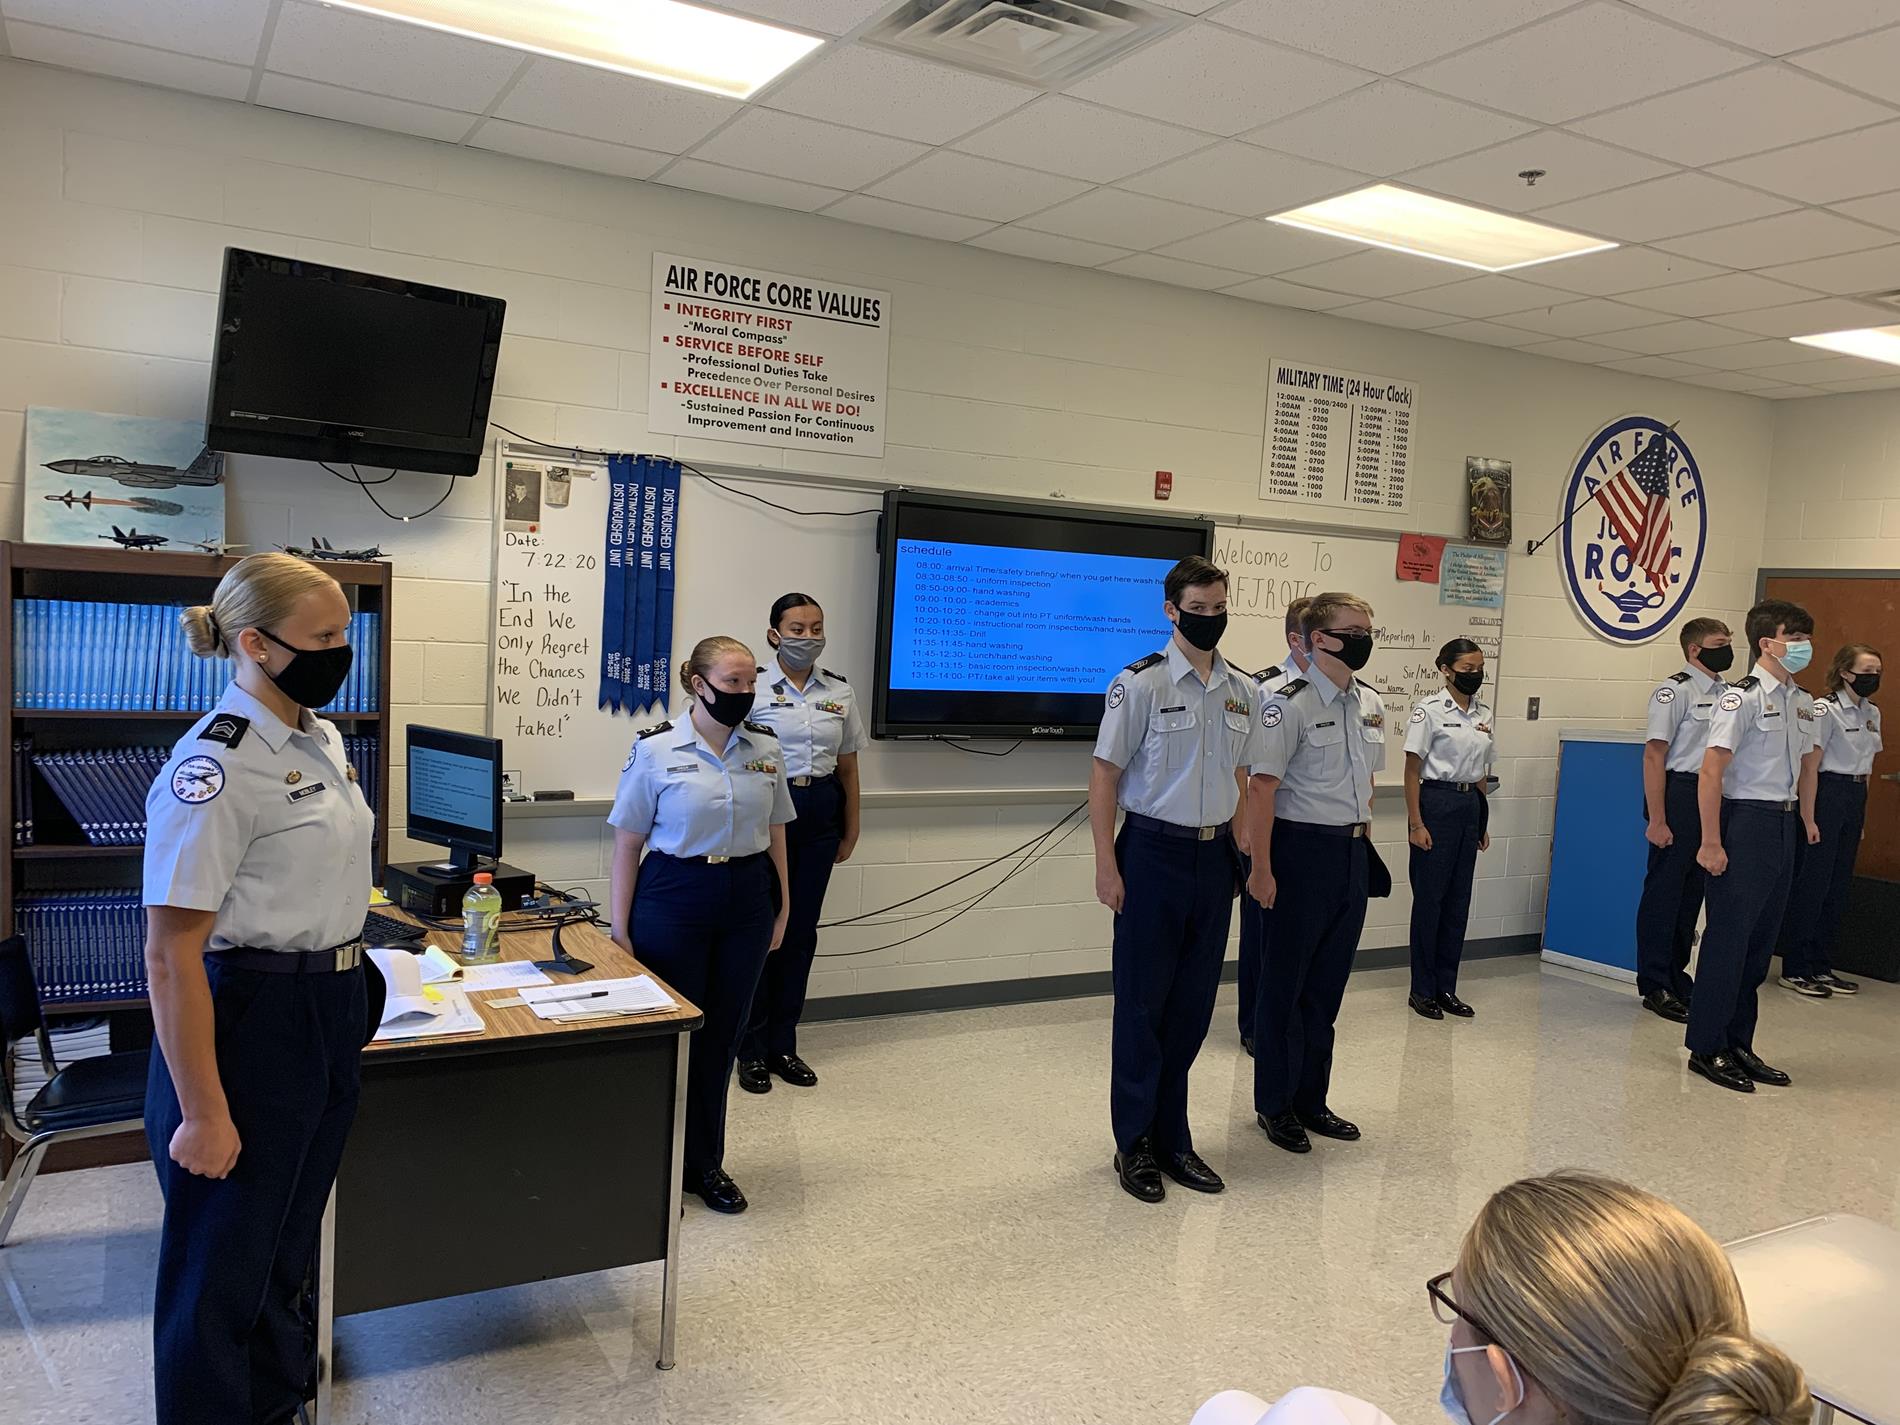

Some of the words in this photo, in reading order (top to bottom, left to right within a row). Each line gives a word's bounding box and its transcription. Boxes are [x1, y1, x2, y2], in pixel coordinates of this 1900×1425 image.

[666, 265, 697, 291] AIR
[704, 271, 760, 301] FORCE
[767, 282, 812, 310] CORE
[818, 290, 880, 321] VALUES
[677, 303, 752, 324] INTEGRITY
[756, 316, 792, 331] FIRST
[732, 328, 787, 345] Compass"
[676, 336, 732, 354] SERVICE
[738, 345, 789, 362] BEFORE
[794, 353, 823, 367] SELF
[764, 364, 798, 378] Duties
[802, 370, 828, 382] Take
[688, 368, 751, 385] Precedence
[753, 377, 781, 390] Over
[785, 381, 833, 396] Personal
[836, 389, 875, 402] Desires
[1277, 367, 1320, 389] MILITARY
[1323, 375, 1344, 393] TIME
[1346, 379, 1360, 399] (24
[1363, 382, 1384, 400] Hour
[1387, 385, 1412, 408] Clock)
[674, 382, 759, 403] EXCELLENCE
[764, 394, 780, 405] IN
[784, 396, 808, 409] ALL
[812, 400, 831, 412] WE
[836, 403, 860, 416] DO!
[1276, 393, 1305, 402] 12:00AM
[1314, 398, 1347, 408] 0000/2400
[1276, 402, 1300, 410] 1:00AM
[1275, 410, 1300, 418] 2:00AM
[1360, 414, 1382, 422] 1:00PM
[1361, 406, 1387, 414] 12:00PM
[688, 415, 766, 433] Improvement
[770, 423, 791, 436] and
[795, 426, 854, 443] Innovation
[748, 408, 791, 422] Passion
[795, 414, 812, 424] For
[816, 417, 875, 433] Continuous
[1274, 419, 1299, 427] 3:00AM
[1360, 422, 1382, 430] 2:00PM
[1273, 436, 1298, 444] 5:00AM
[1274, 427, 1298, 436] 4:00AM
[1359, 430, 1381, 439] 3:00PM
[1272, 445, 1297, 453] 6:00AM
[1358, 439, 1380, 447] 4:00PM
[1584, 440, 1622, 496] AIR
[1634, 432, 1697, 508] FRCE
[1269, 487, 1297, 496] 11:00AM
[1270, 479, 1298, 487] 10:00AM
[610, 484, 624, 545] DISTINGUISHED
[642, 486, 656, 547] DISTINGUISHED
[661, 488, 674, 548] DISTINGUISHED
[506, 533, 544, 546] Date:
[610, 550, 621, 568] UNIT
[901, 545, 952, 556] schedule
[1213, 534, 1289, 568] Welcome
[1312, 542, 1332, 572] To
[641, 551, 652, 569] UNIT
[660, 553, 671, 570] UNIT
[1585, 543, 1681, 583] ROC
[976, 566, 1023, 576] Time/safety
[502, 581, 532, 603] "In
[544, 583, 571, 603] the
[1010, 580, 1051, 589] inspection
[996, 590, 1030, 598] washing
[499, 608, 533, 628] End
[548, 610, 576, 629] We
[974, 610, 1005, 618] change
[974, 620, 1023, 628] instructional
[1381, 627, 1415, 647] Reporting
[498, 635, 533, 656] Only
[541, 634, 589, 659] Regret
[989, 642, 1023, 650] washing
[498, 658, 521, 676] the
[529, 659, 585, 679] Chances
[1375, 674, 1388, 684] Last
[498, 686, 521, 706] We
[536, 687, 582, 707] Didn't
[515, 713, 570, 738] take!"
[1394, 721, 1403, 736] the
